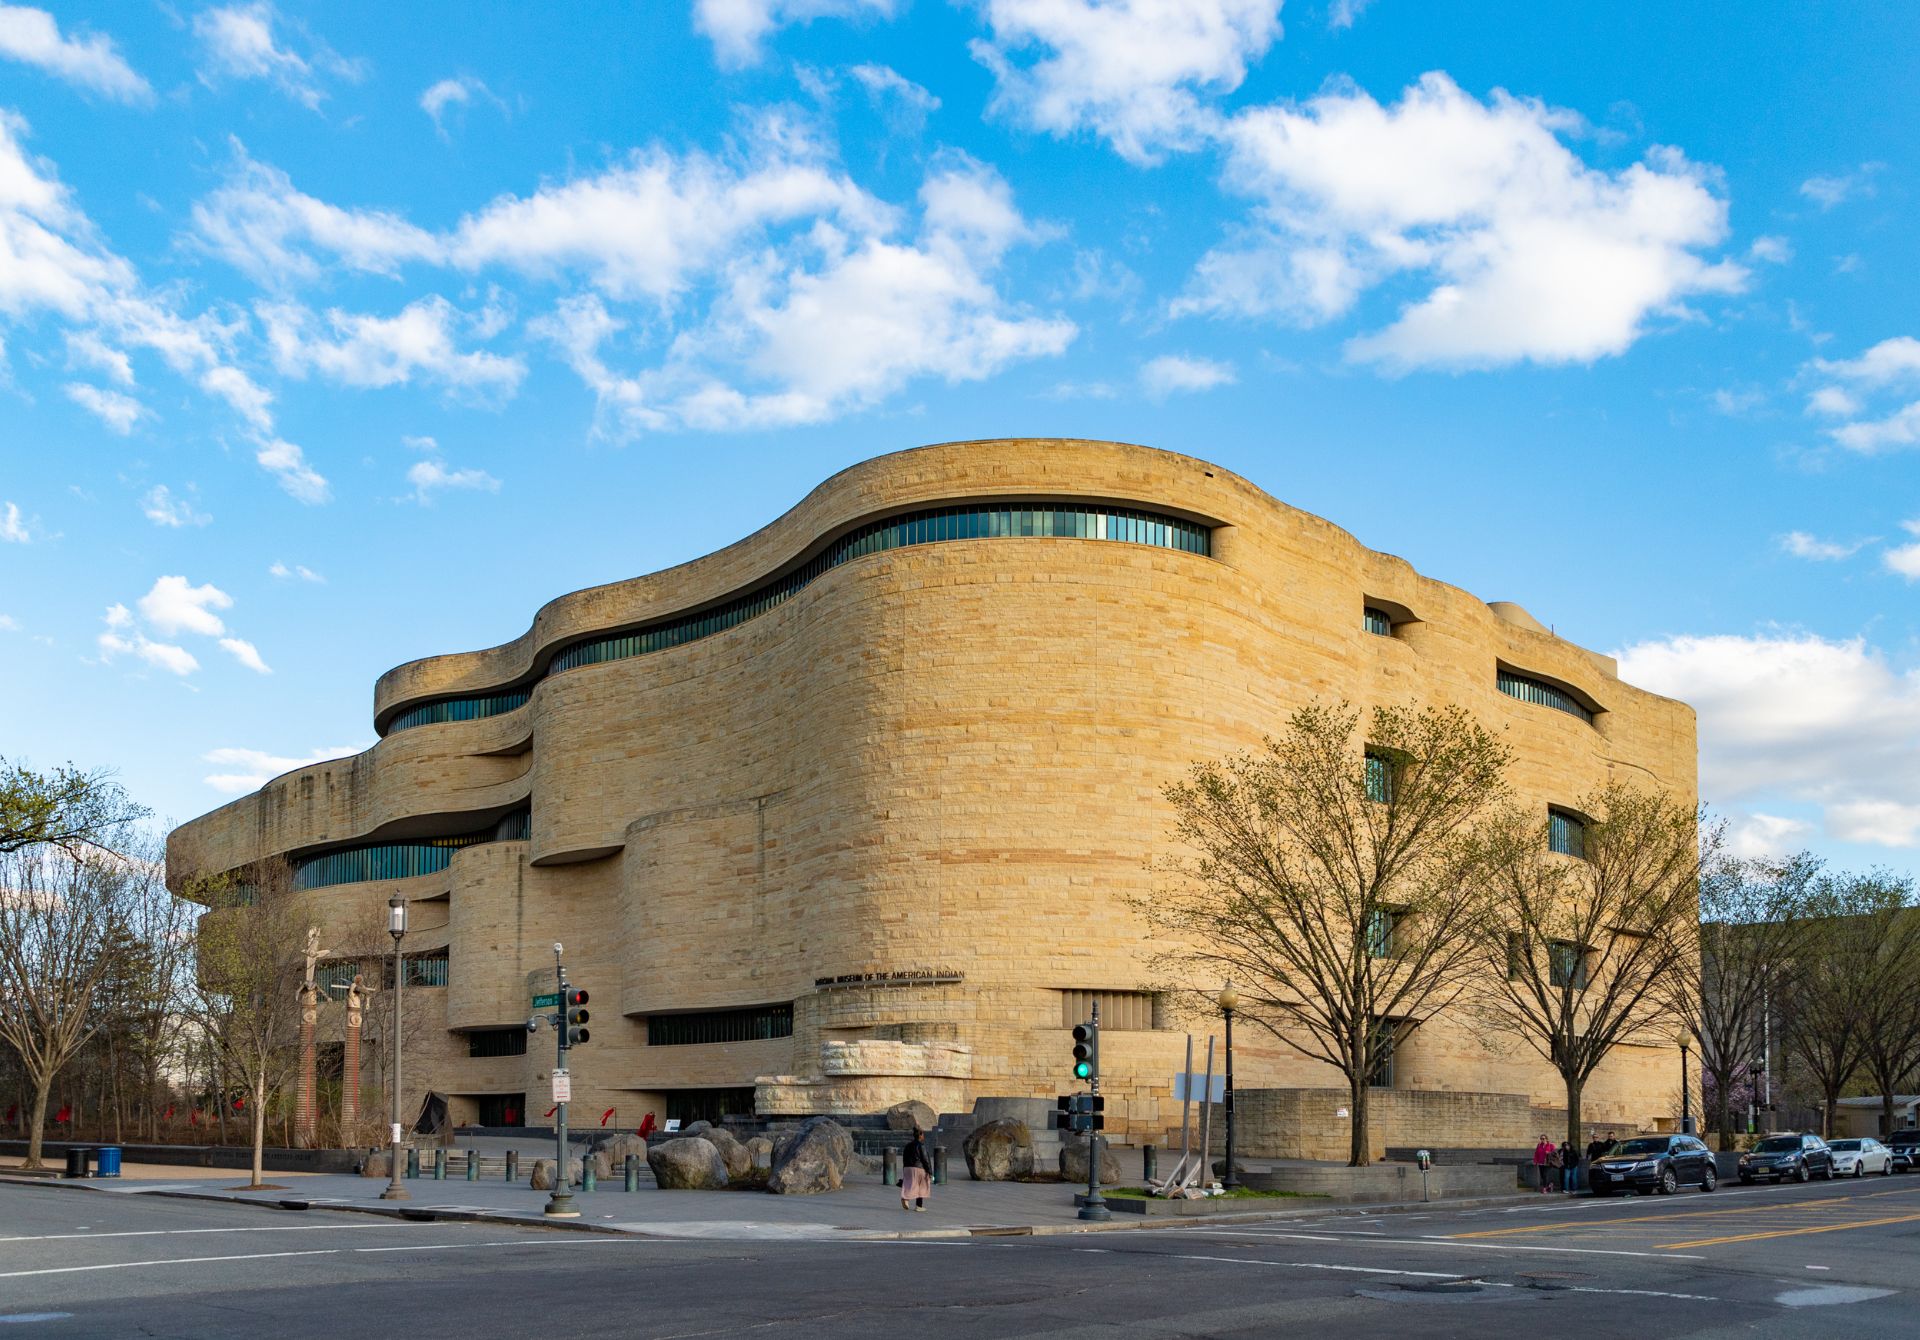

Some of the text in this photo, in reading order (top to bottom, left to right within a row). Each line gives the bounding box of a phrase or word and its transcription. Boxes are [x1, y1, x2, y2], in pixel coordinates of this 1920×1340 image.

[864, 973, 874, 981] OF
[876, 972, 889, 980] THE
[891, 970, 933, 979] AMERICAN
[936, 970, 965, 979] INDIAN
